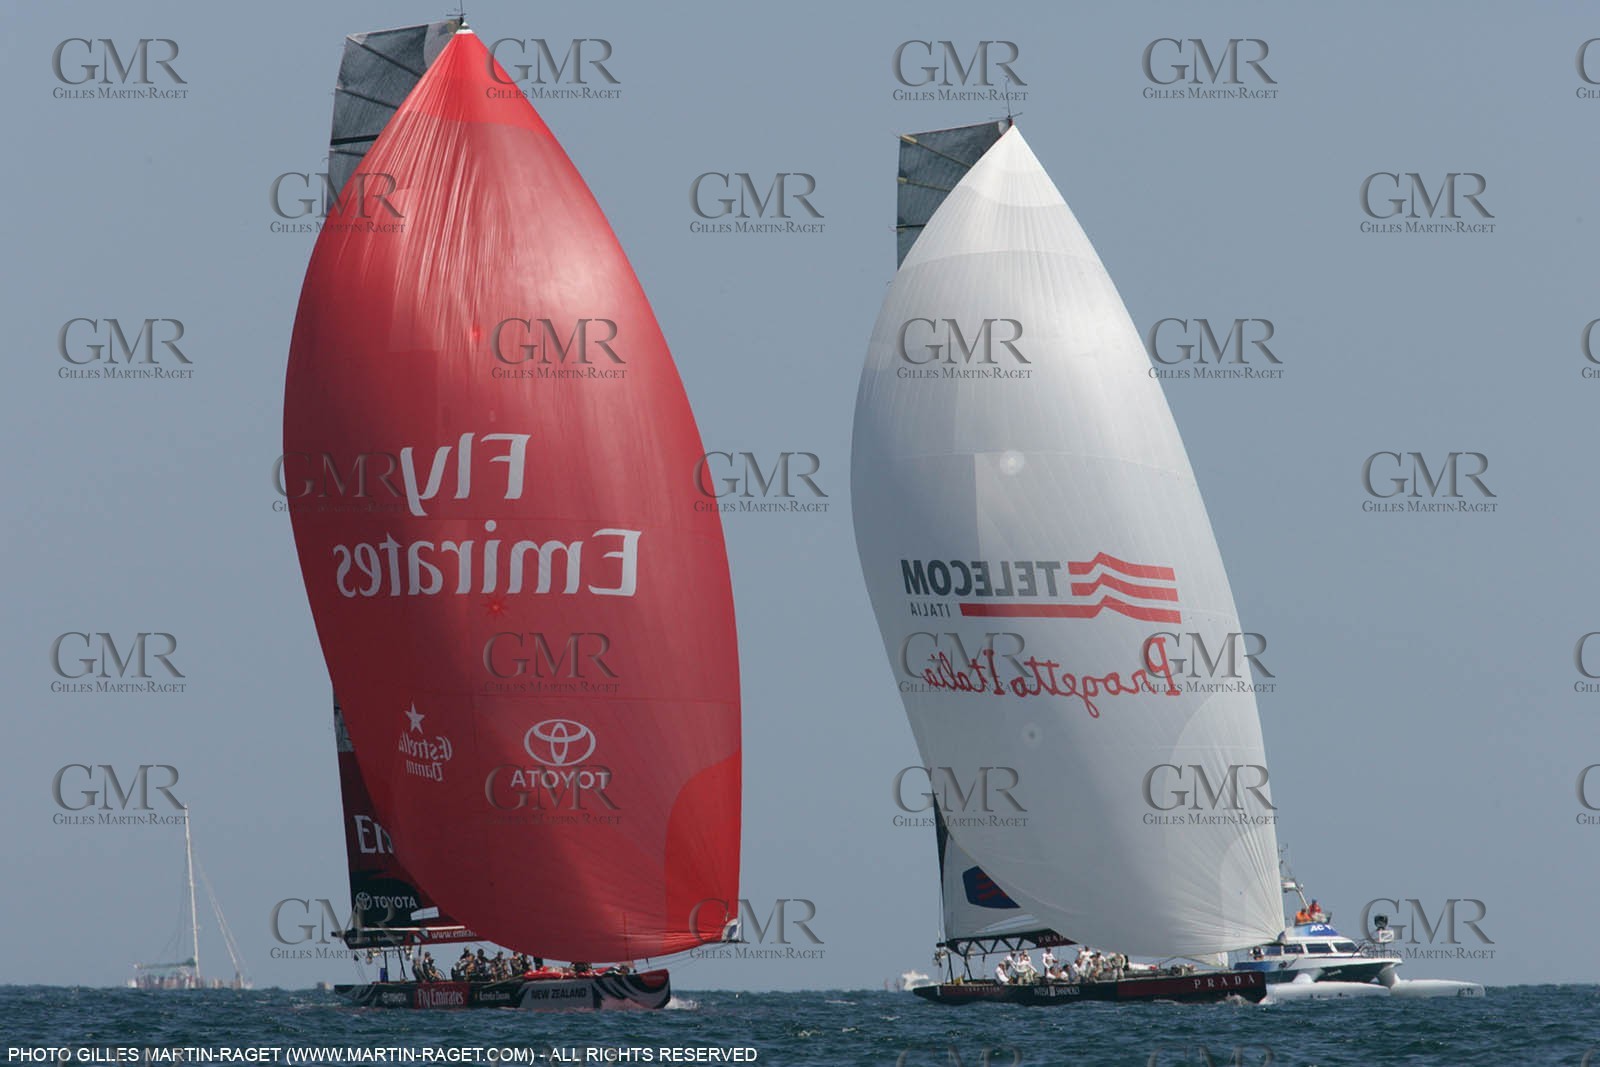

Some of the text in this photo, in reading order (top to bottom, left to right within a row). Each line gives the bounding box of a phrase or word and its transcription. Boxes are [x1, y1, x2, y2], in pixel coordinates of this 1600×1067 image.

[372, 895, 418, 909] TOYOTA
[1194, 973, 1255, 989] PRADA
[431, 988, 464, 1005] Emirates
[531, 987, 587, 1000] NEW ZEALAND
